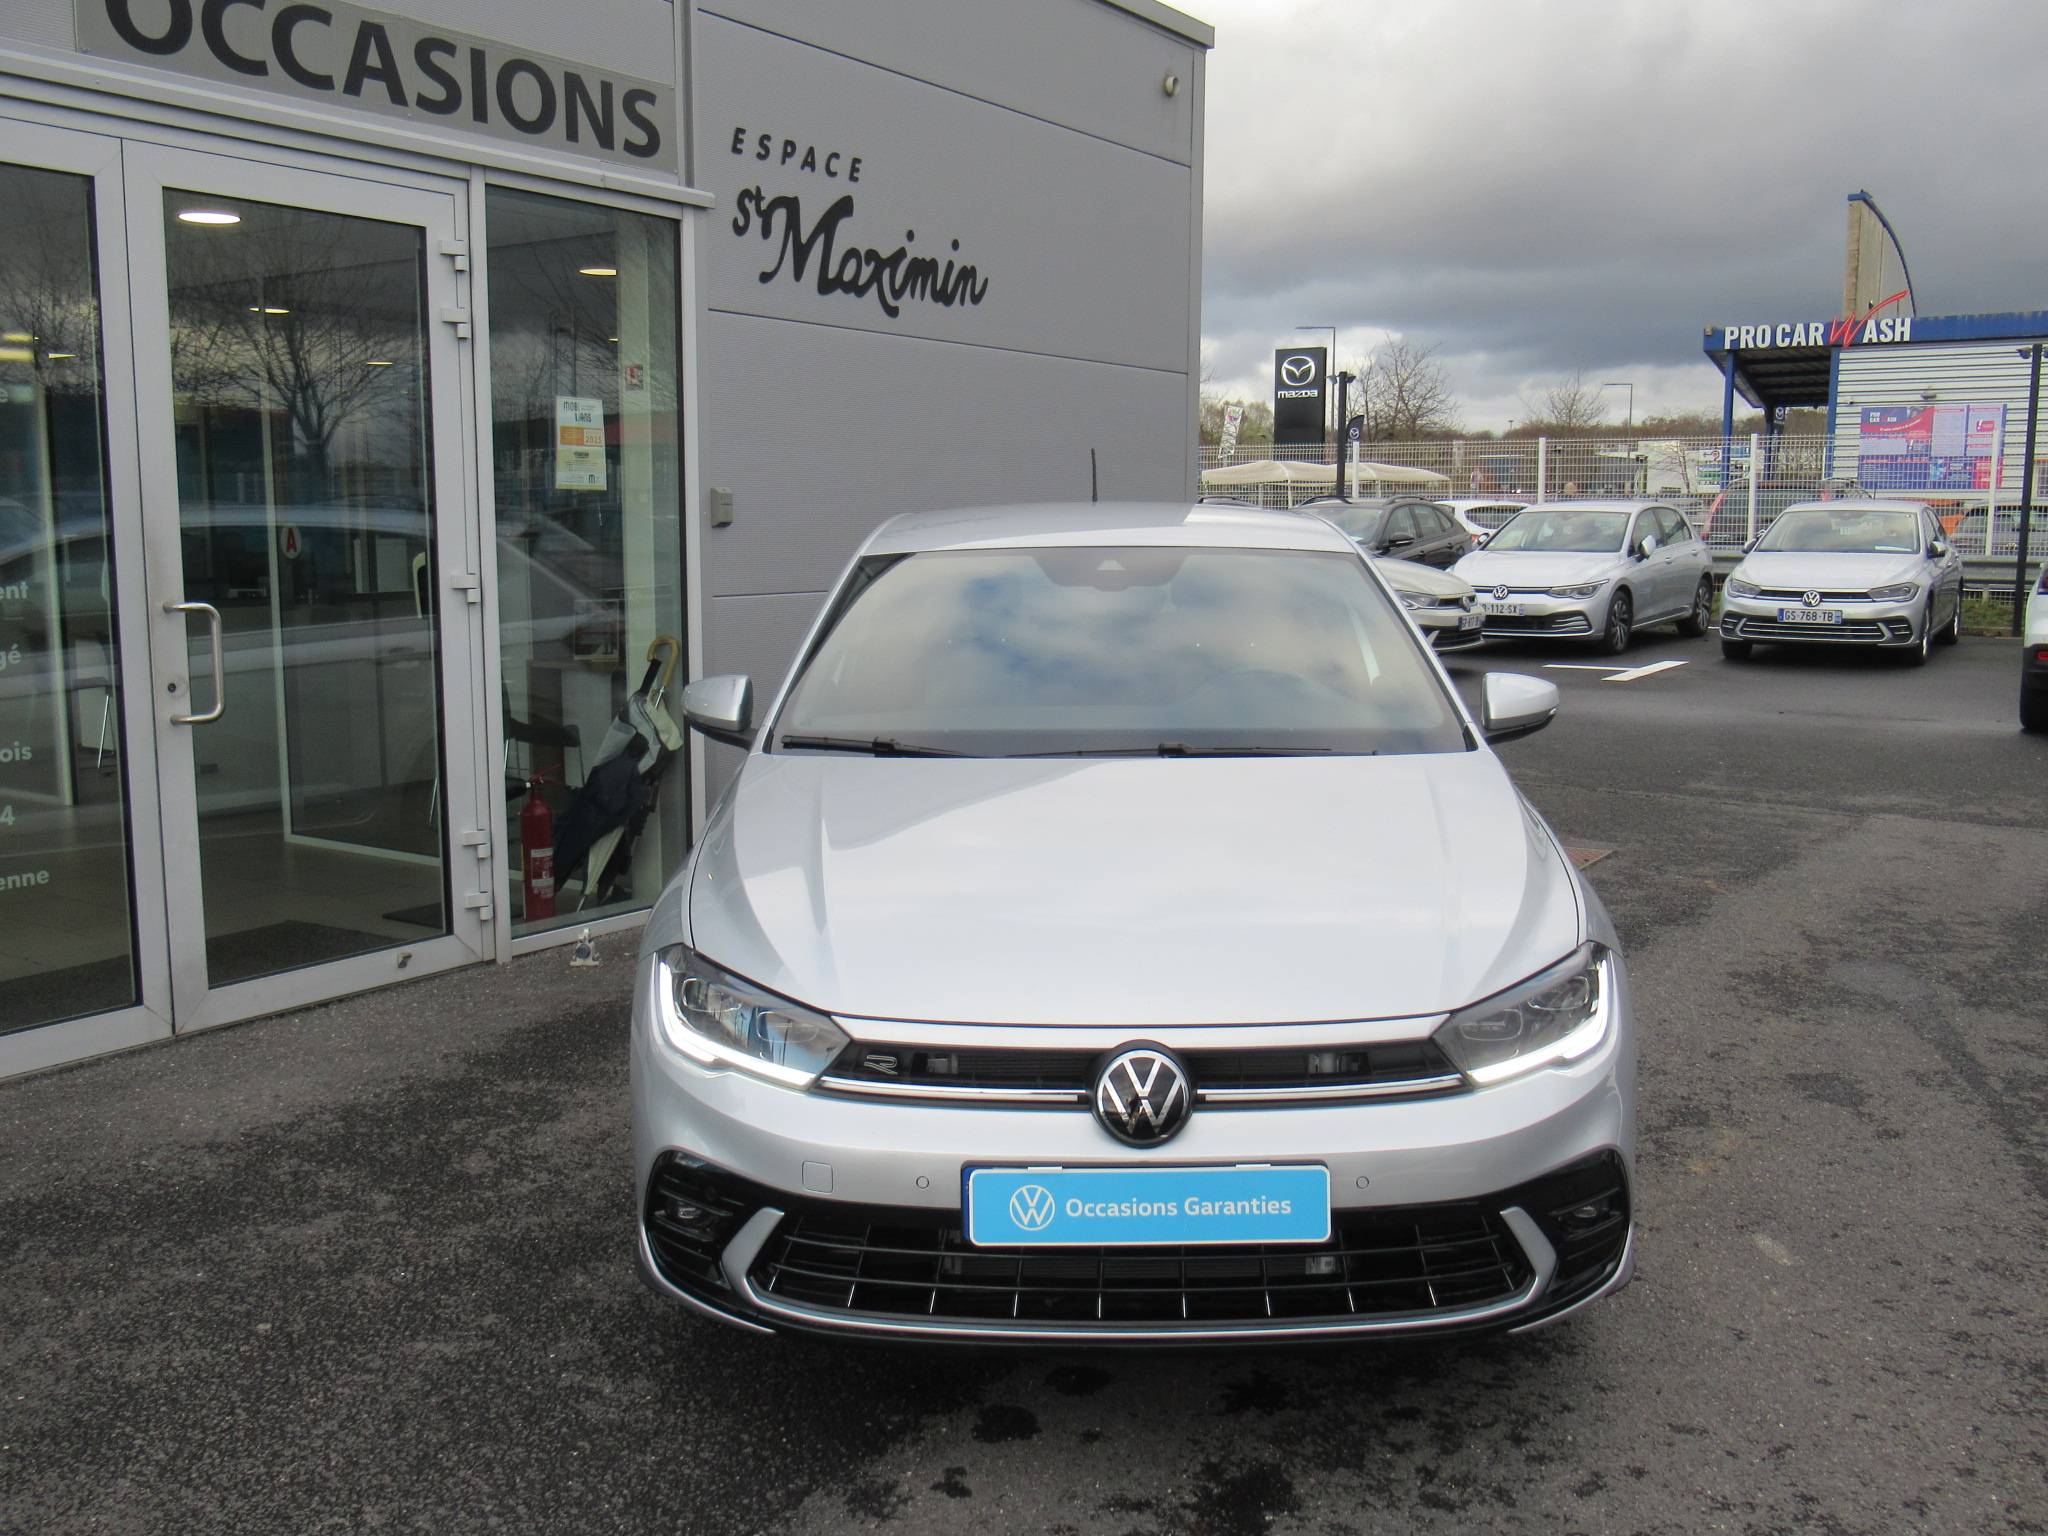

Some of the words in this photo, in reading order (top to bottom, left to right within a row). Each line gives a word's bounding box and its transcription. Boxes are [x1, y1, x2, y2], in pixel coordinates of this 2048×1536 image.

[107, 0, 661, 158] OCCASIONS
[731, 127, 862, 182] ESPACE
[758, 194, 989, 319] Maximin
[1724, 324, 1771, 350] PRO
[1776, 322, 1825, 348] CAR
[1829, 290, 1911, 349] WASH
[1277, 389, 1319, 399] mazda
[1065, 1197, 1178, 1217] Occasions
[1184, 1195, 1292, 1216] Garanties
